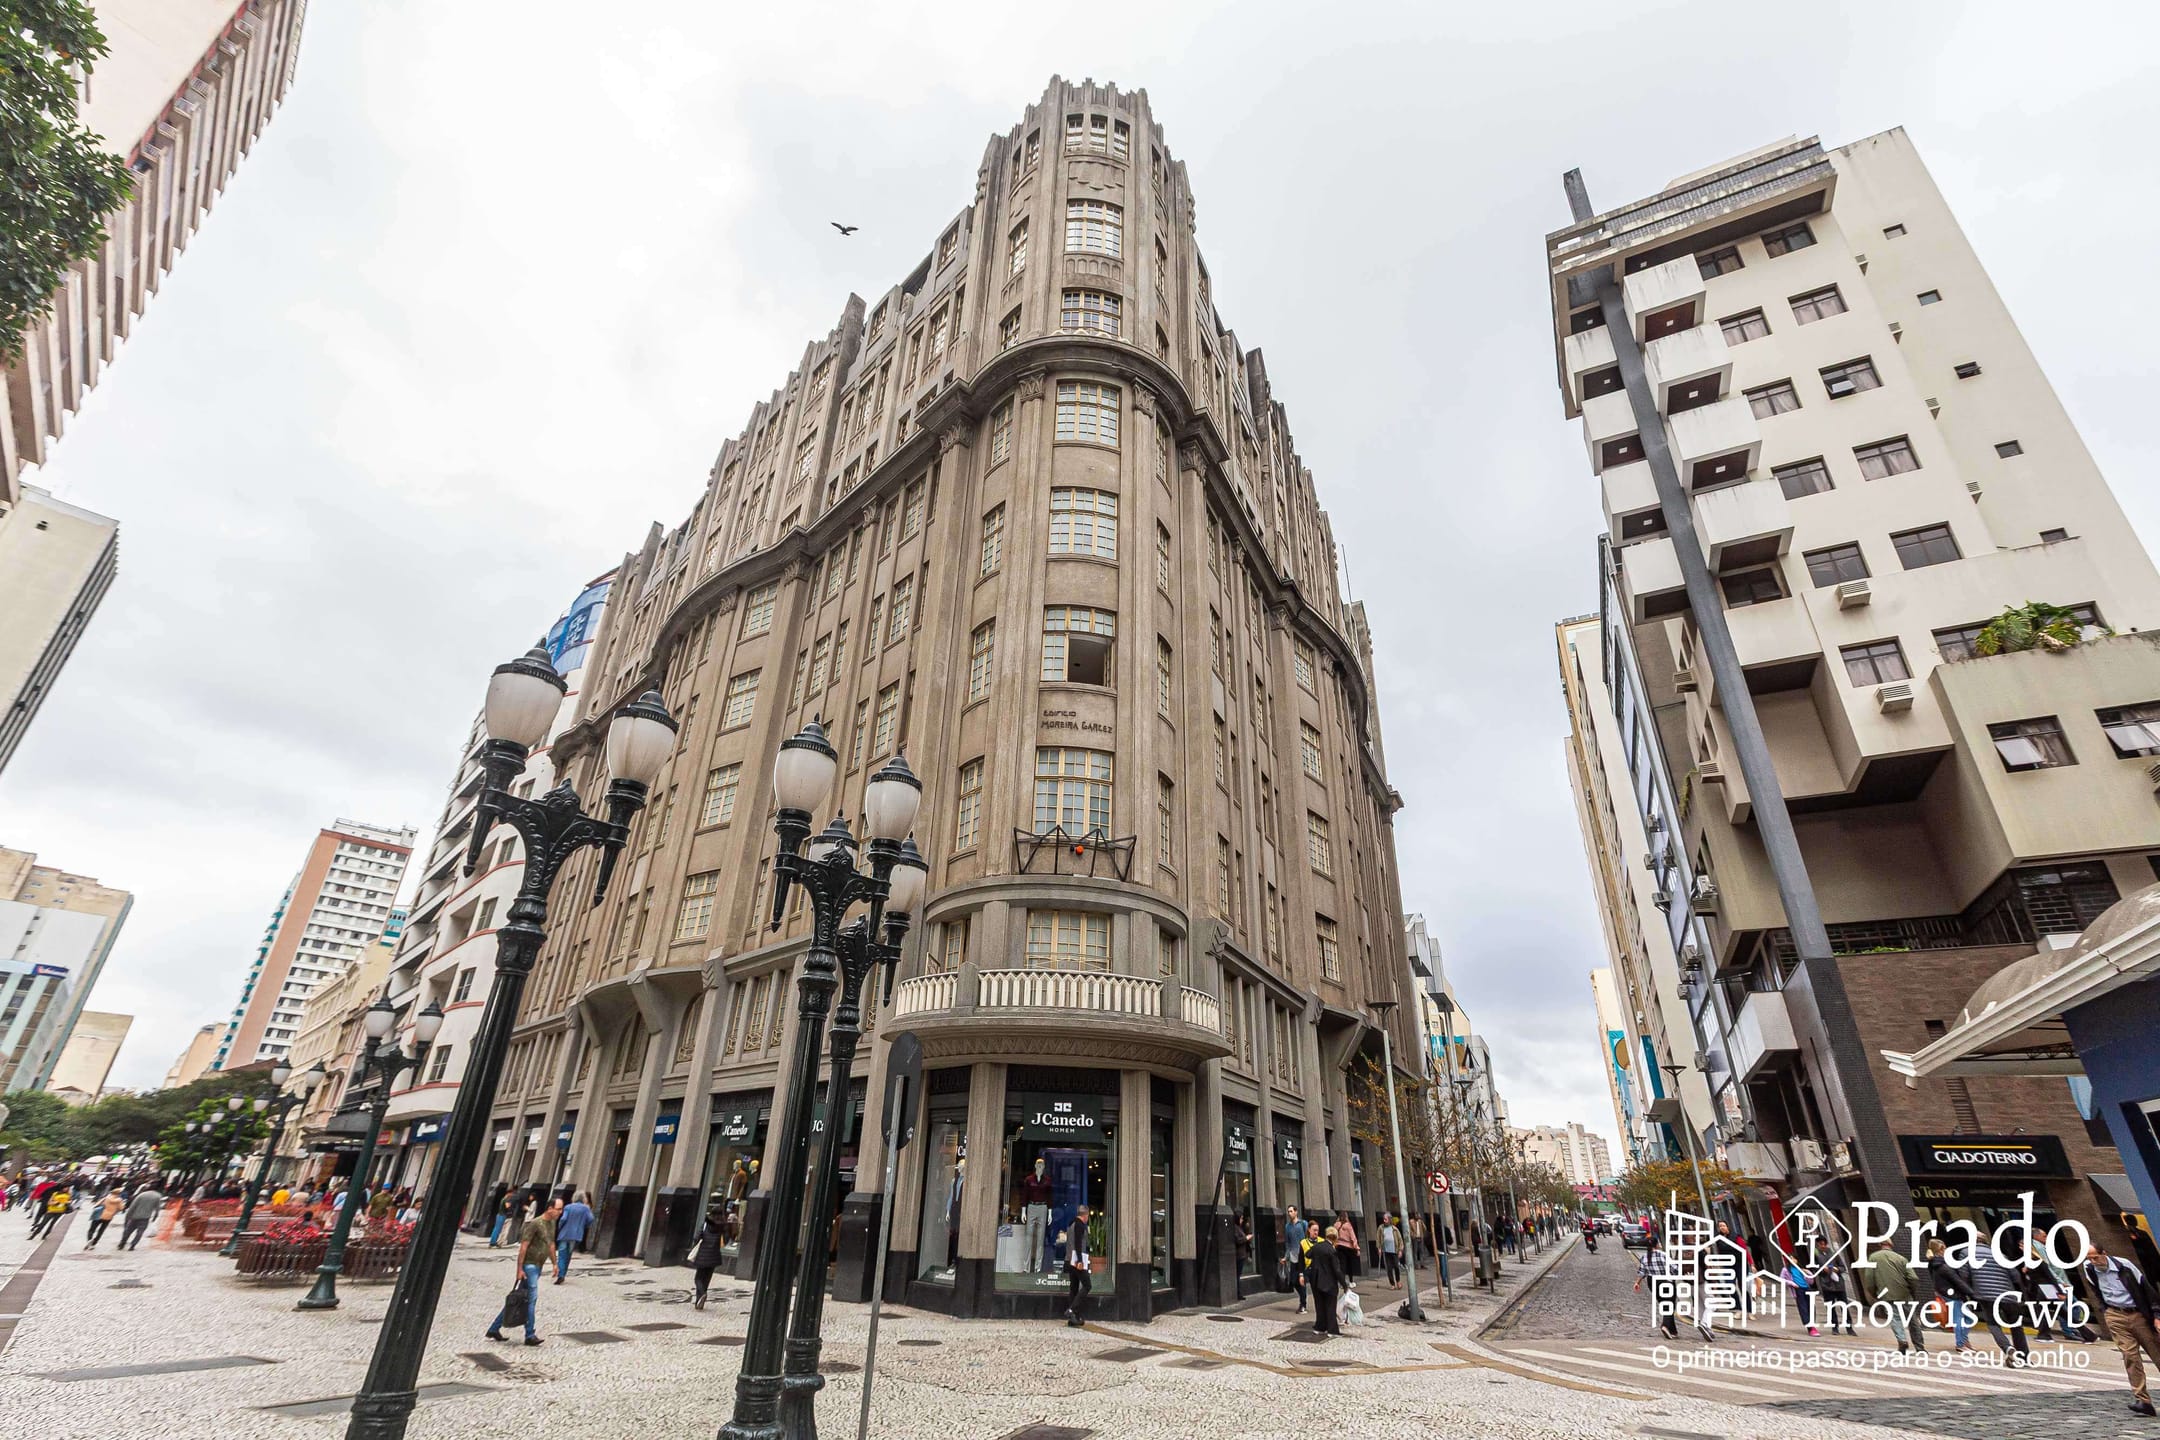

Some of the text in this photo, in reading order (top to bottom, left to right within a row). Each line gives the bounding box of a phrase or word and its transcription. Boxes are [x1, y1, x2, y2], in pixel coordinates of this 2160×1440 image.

[1041, 721, 1113, 734] MOREIRA GARCEZ
[1031, 1112, 1094, 1127] JCanedo
[722, 1124, 748, 1136] JCanedo
[1229, 1136, 1247, 1151] JCanedo
[1920, 1185, 1960, 1198] Terno
